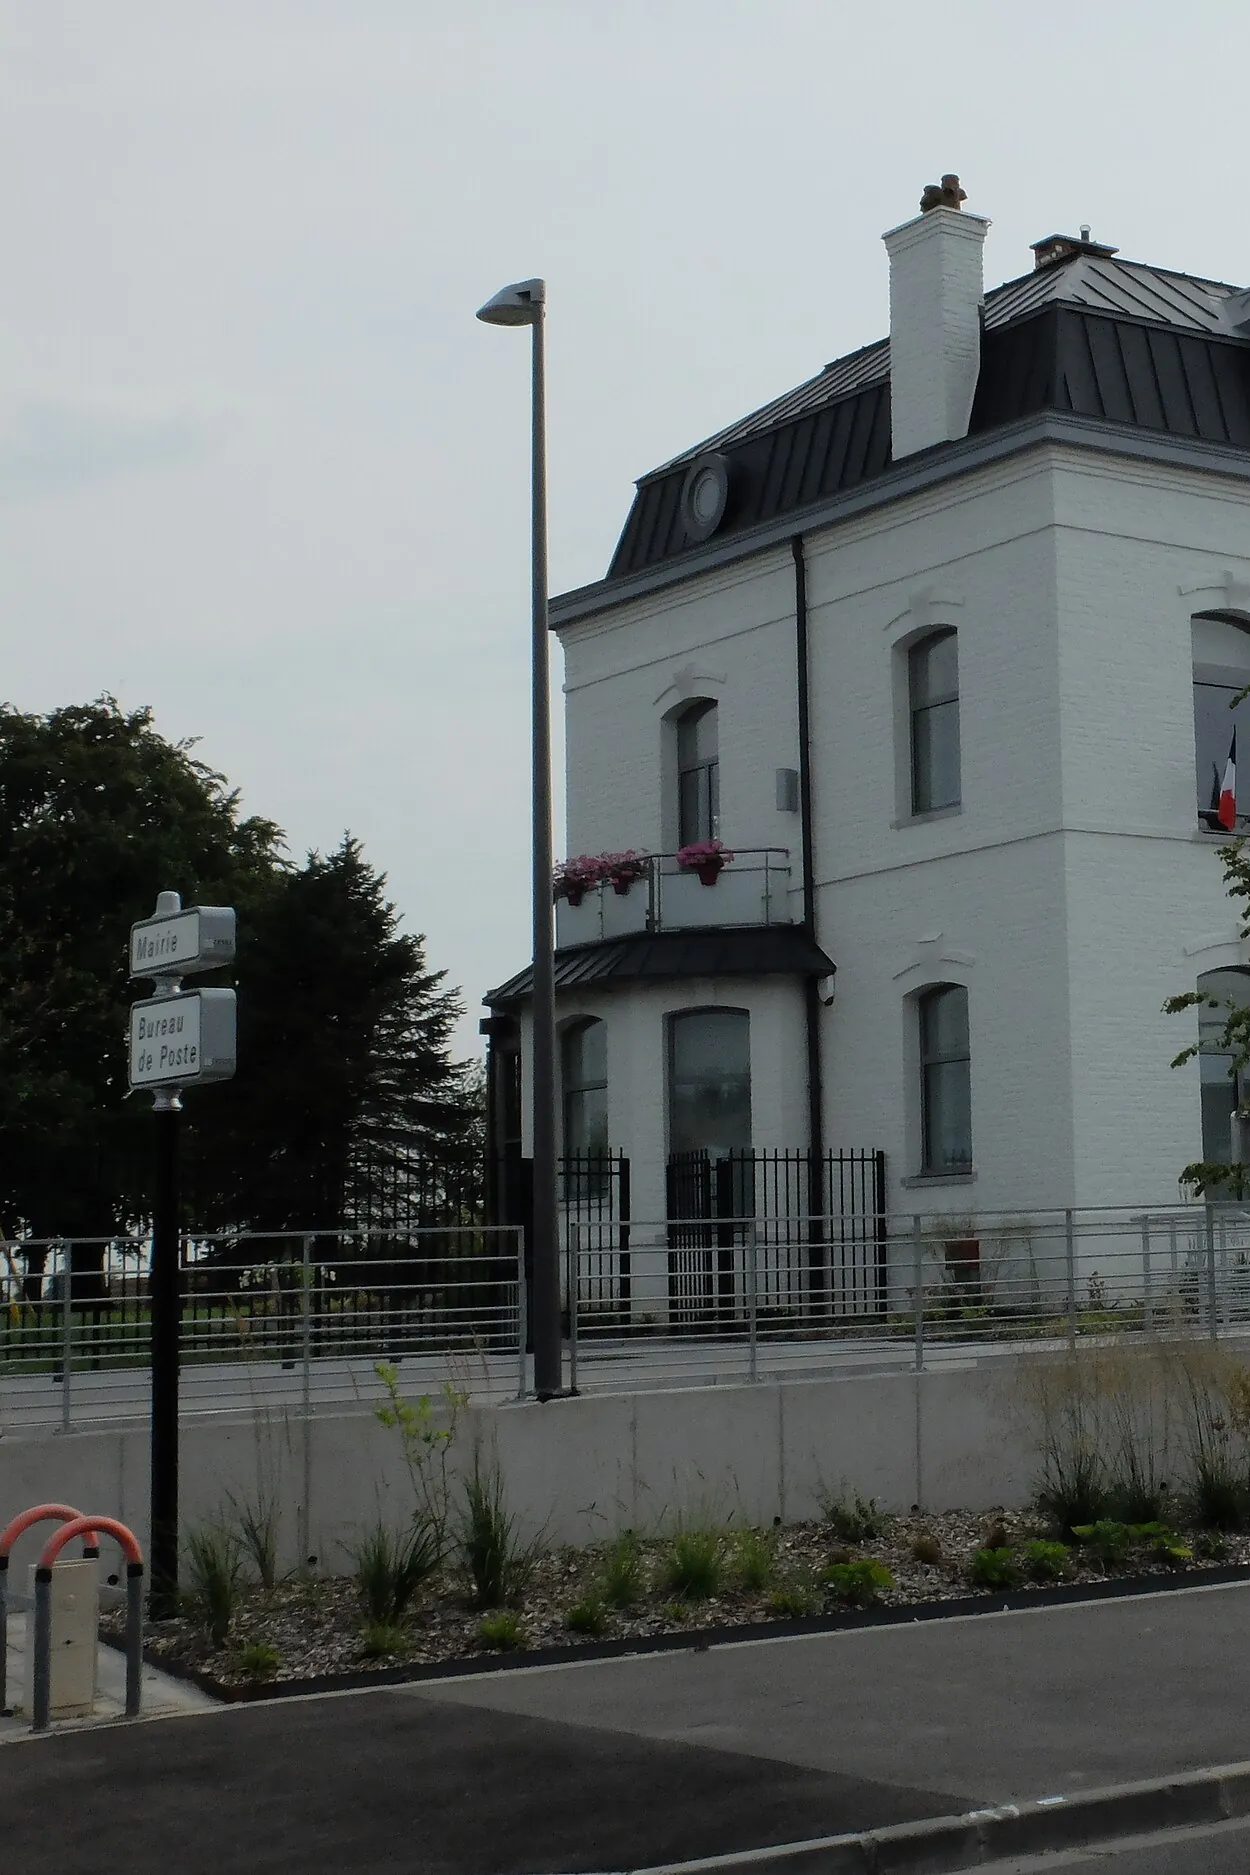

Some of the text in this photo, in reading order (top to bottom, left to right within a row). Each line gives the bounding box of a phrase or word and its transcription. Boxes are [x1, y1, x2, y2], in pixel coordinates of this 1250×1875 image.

[136, 930, 178, 960] Mairie
[138, 1013, 184, 1040] Bureau
[138, 1043, 197, 1072] de Poste
